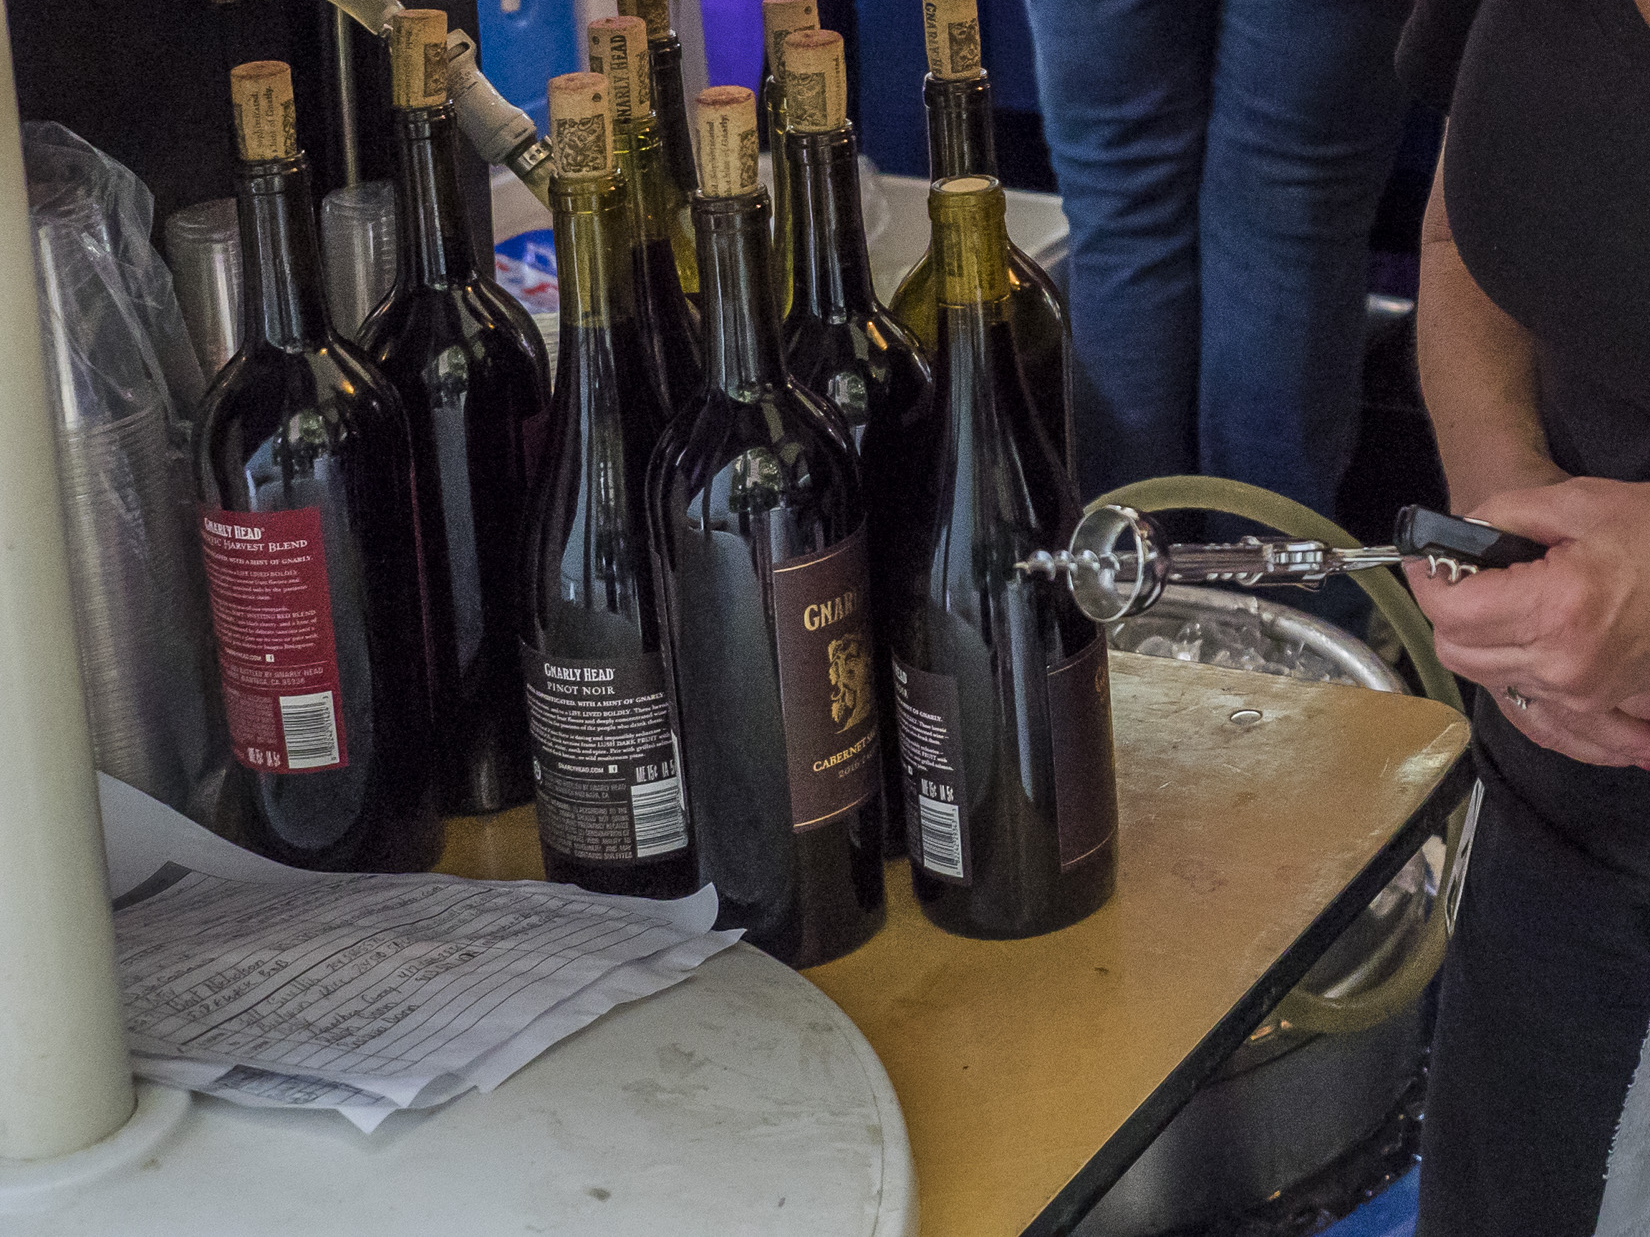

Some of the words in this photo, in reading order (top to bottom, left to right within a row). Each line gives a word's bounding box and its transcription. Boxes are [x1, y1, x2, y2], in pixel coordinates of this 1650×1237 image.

[610, 34, 629, 73] HEAD
[234, 525, 262, 540] HEAD
[224, 538, 265, 551] HARVEST
[268, 540, 308, 552] BLEND
[544, 662, 581, 681] GNARLY
[584, 667, 614, 682] HEAD
[547, 681, 579, 695] PINOT
[582, 686, 615, 695] NOIR
[813, 736, 867, 772] CABERNET
